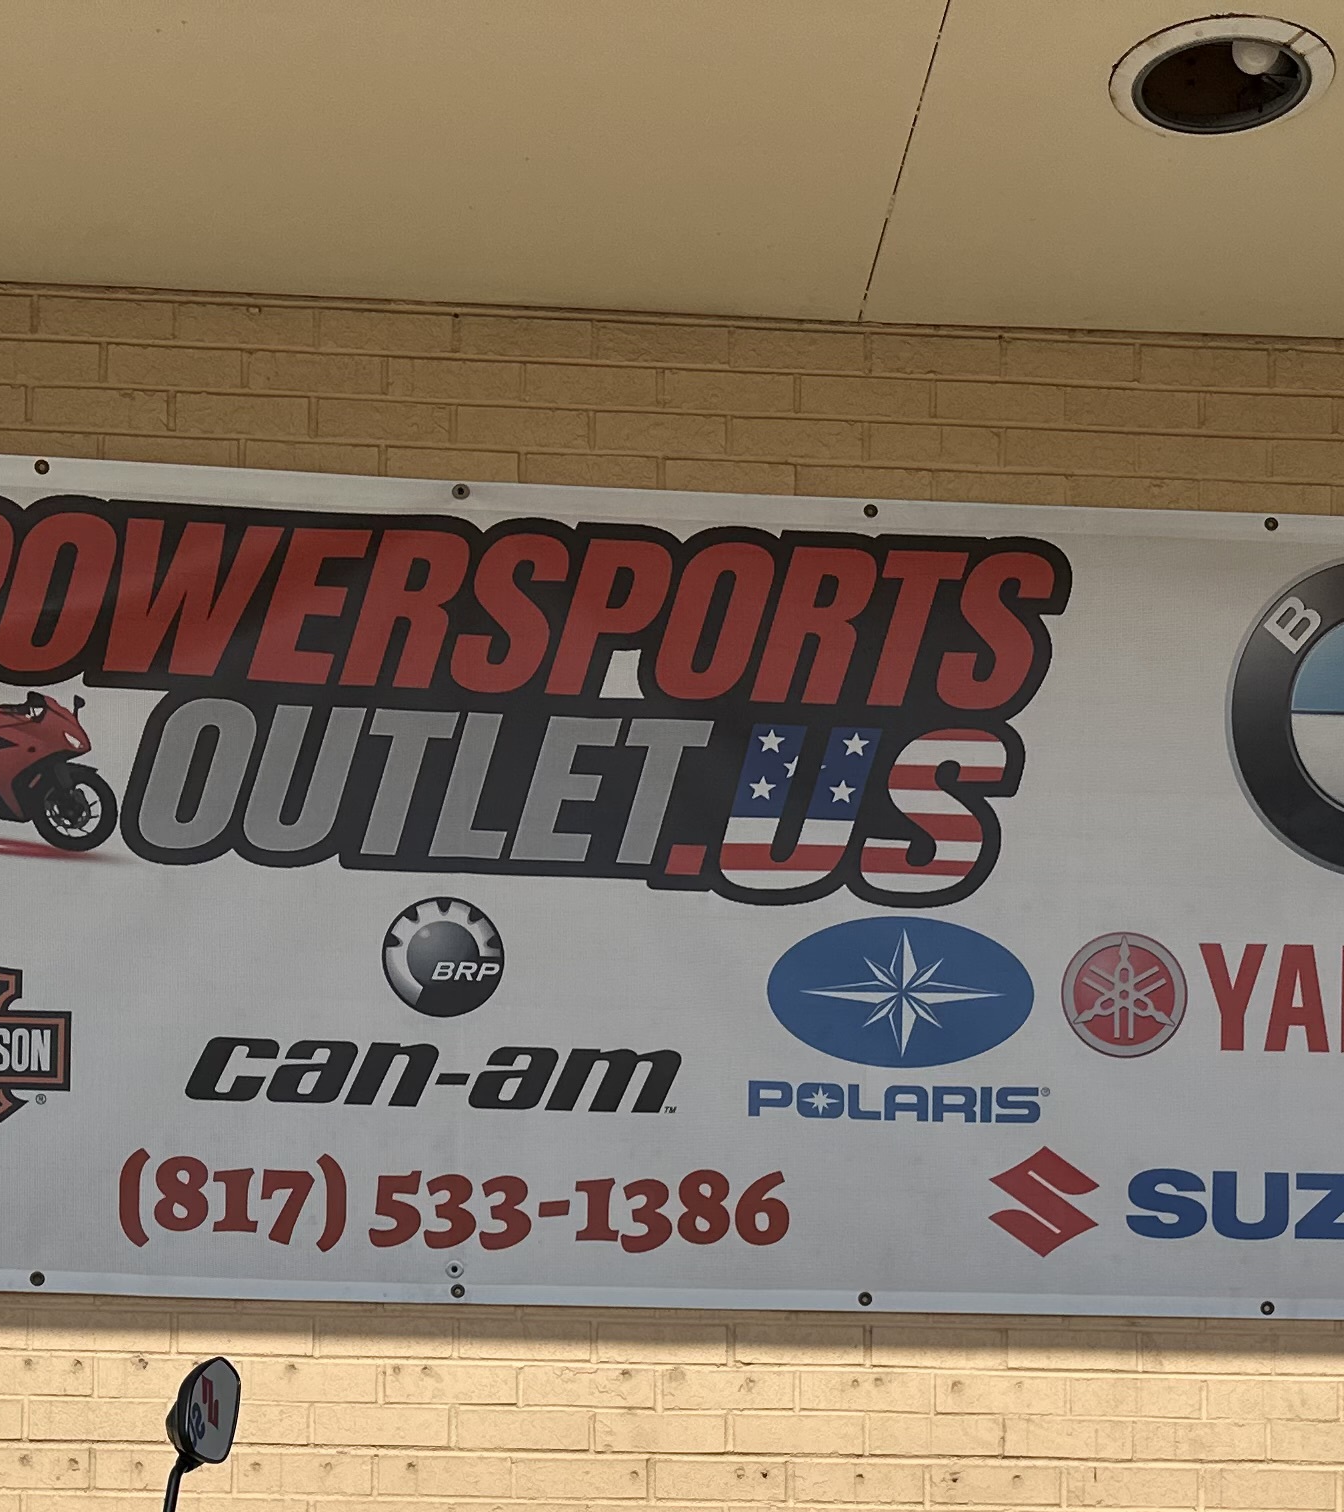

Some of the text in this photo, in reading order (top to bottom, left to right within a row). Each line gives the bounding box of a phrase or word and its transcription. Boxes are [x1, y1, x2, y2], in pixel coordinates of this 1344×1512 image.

[136, 695, 1010, 879] OUTLET.US
[431, 960, 501, 982] BRP
[747, 1079, 1042, 1124] POLARIS
[118, 1148, 790, 1254] (817) 533-1386
